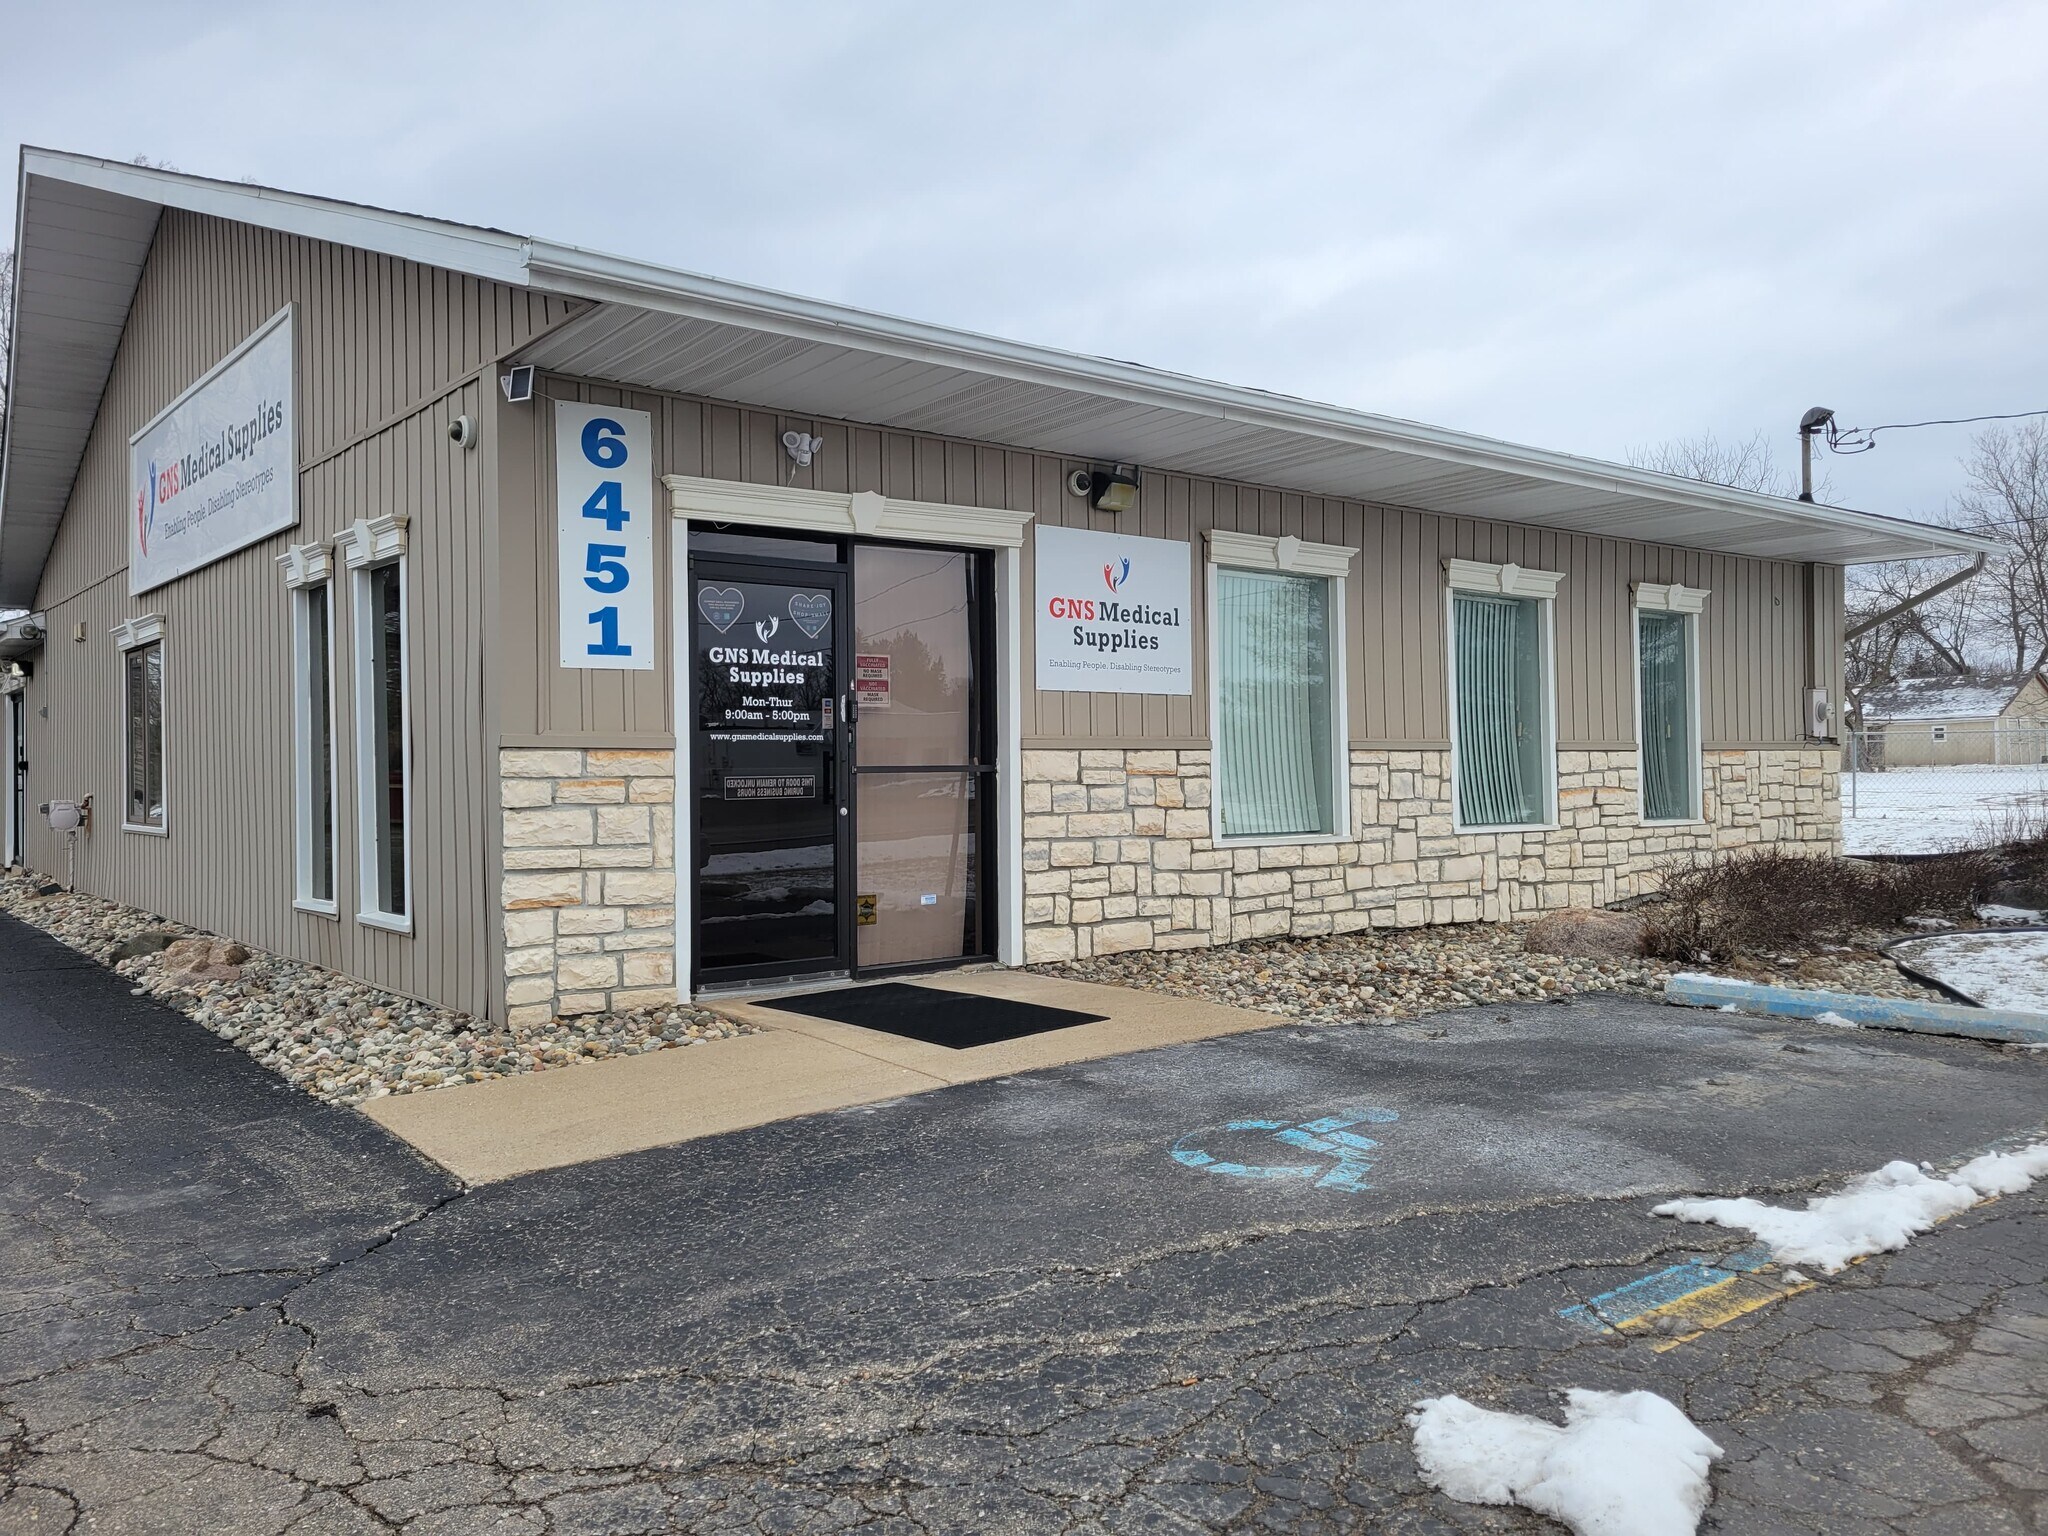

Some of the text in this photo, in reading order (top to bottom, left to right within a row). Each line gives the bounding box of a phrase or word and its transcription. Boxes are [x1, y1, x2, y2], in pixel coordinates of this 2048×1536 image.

[159, 399, 283, 504] GNS Medical Supplies
[164, 517, 187, 540] Enabling
[207, 488, 235, 516] Disabling
[235, 466, 274, 500] Stereotypes
[581, 417, 633, 656] 6451
[1049, 597, 1180, 627] GNS Medical
[1073, 625, 1159, 653] Supplies
[709, 647, 824, 667] GNS Medical
[1049, 659, 1082, 670] Enabling
[1110, 662, 1142, 673] Disabling
[1143, 664, 1181, 675] Stereotypes
[729, 667, 805, 687] Supplies
[742, 696, 793, 707] Mon-Thur
[725, 710, 764, 720] 9:00am
[772, 711, 810, 722] 5:00pm
[710, 732, 824, 742] www.gnsmedicalsupplies.com
